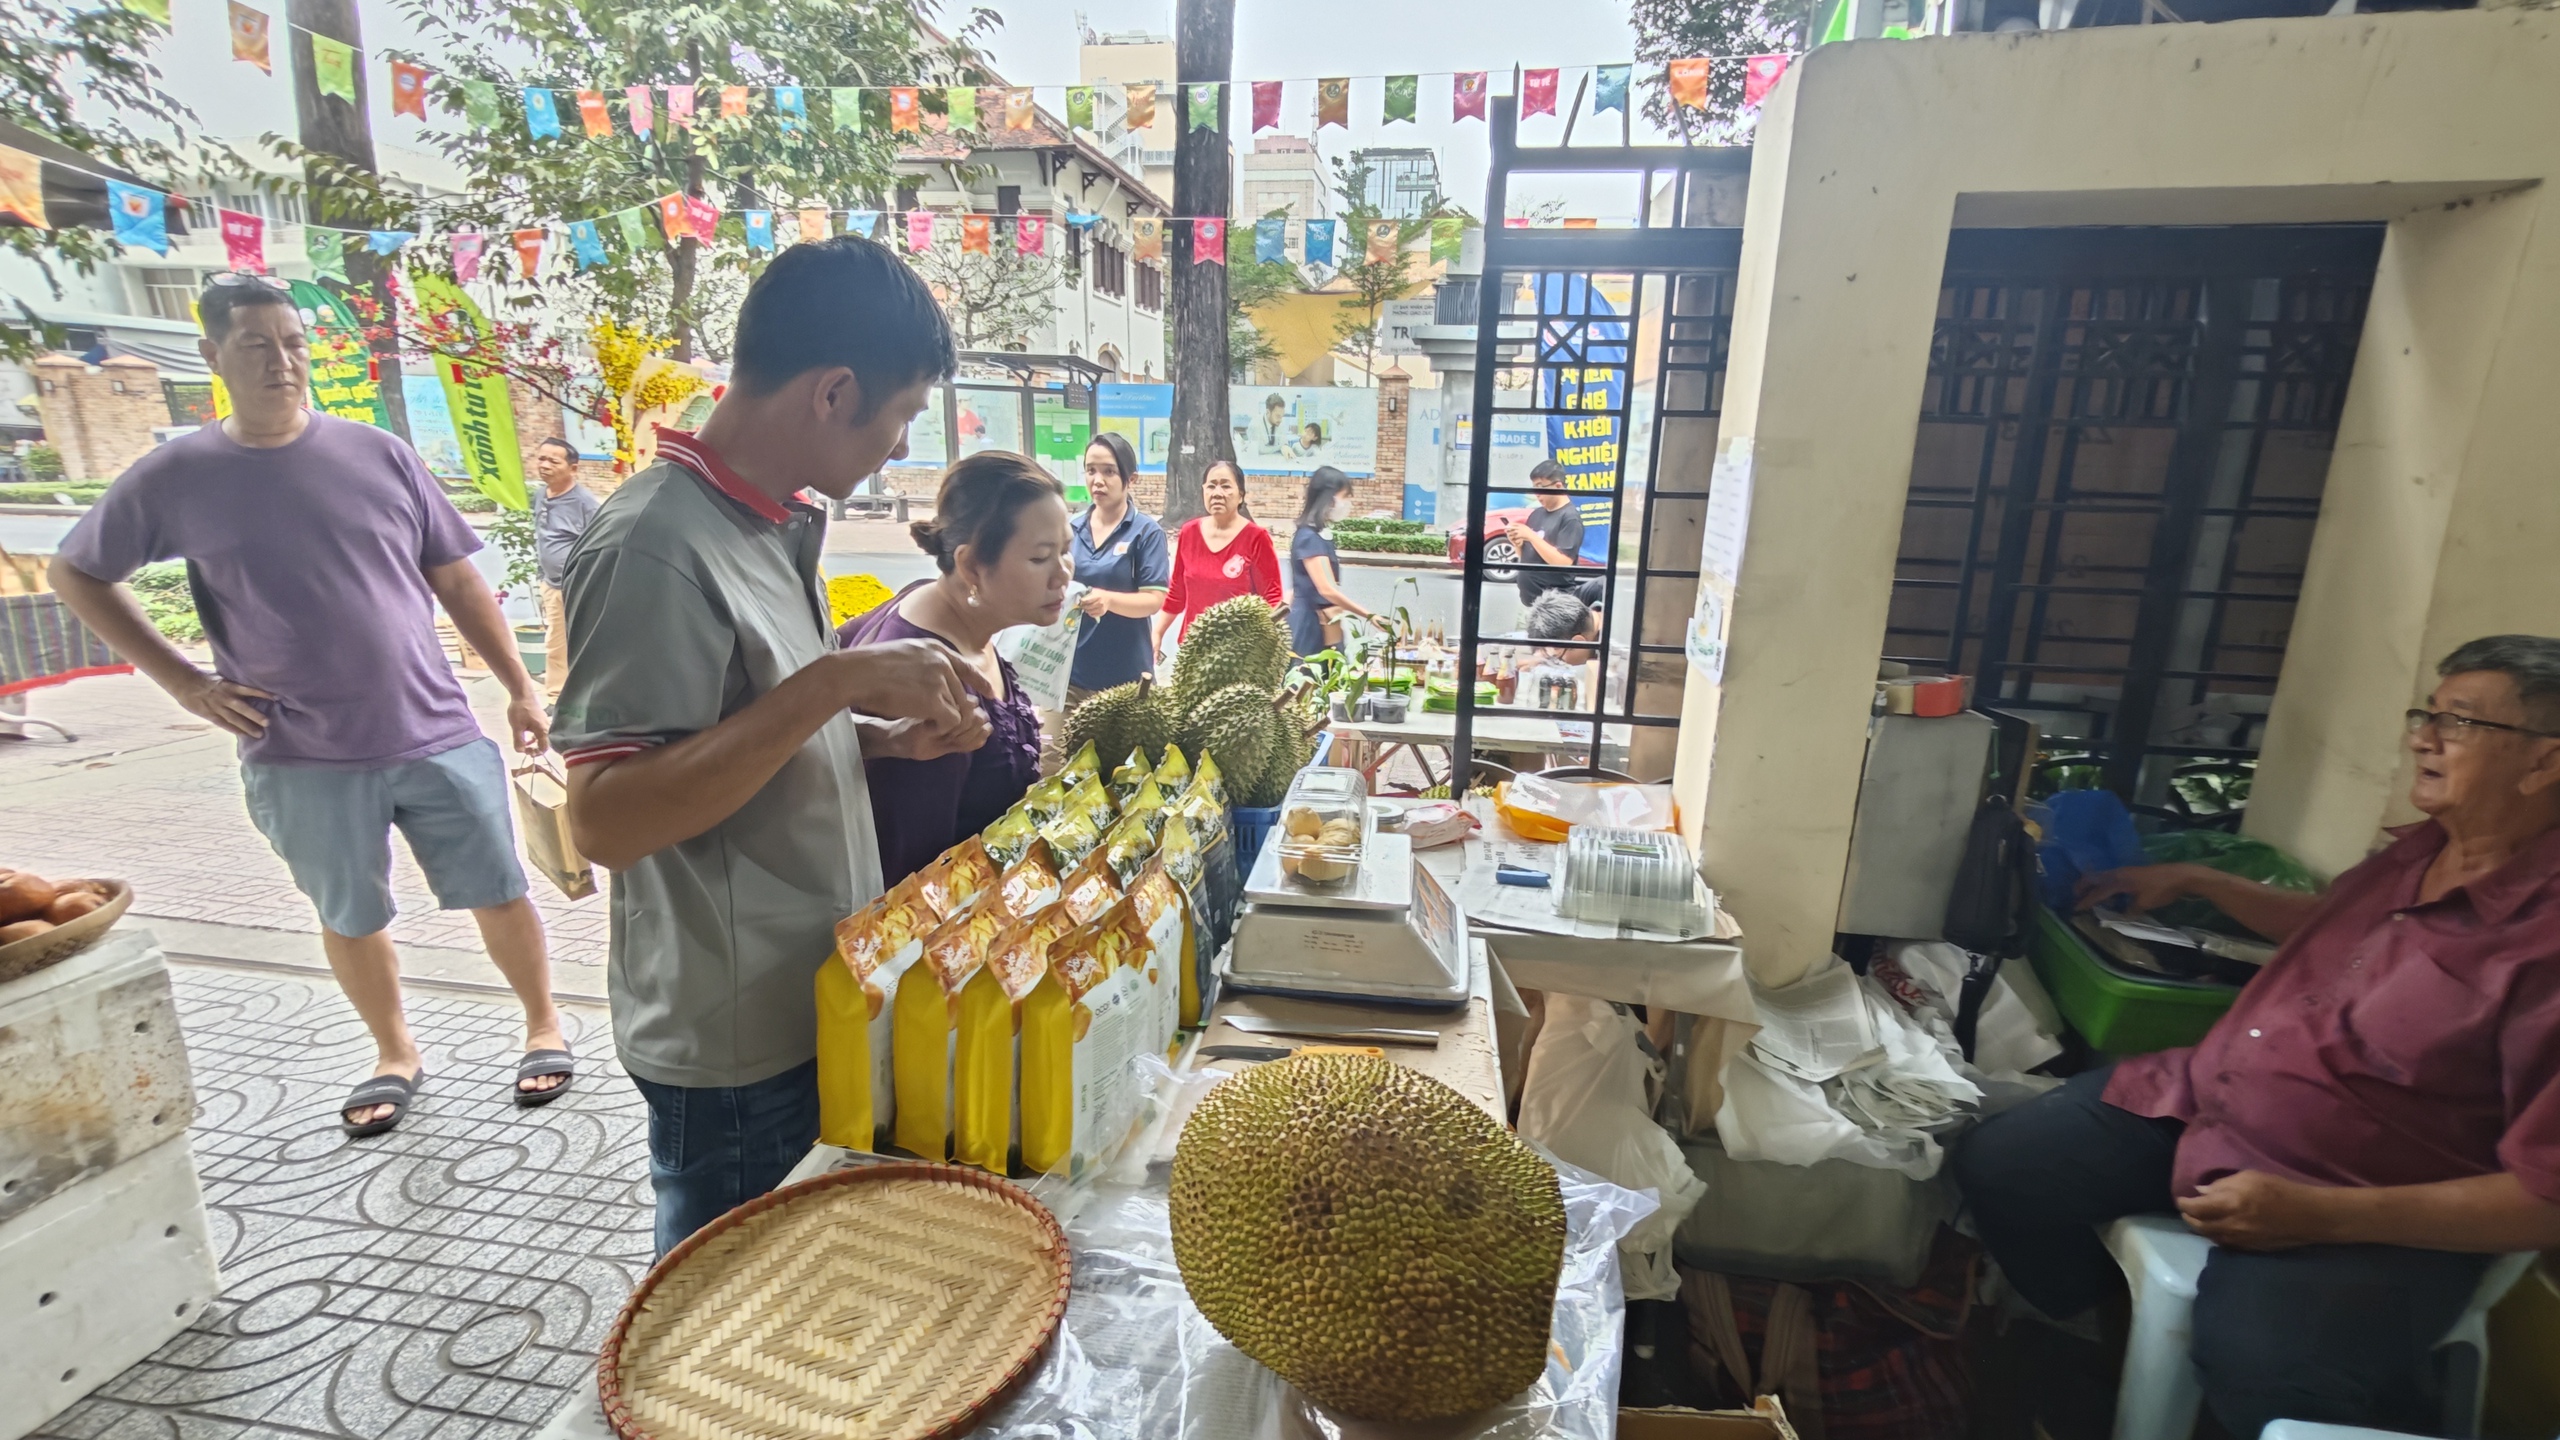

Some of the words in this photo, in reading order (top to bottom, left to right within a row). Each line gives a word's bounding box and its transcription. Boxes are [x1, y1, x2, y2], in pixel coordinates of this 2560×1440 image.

[462, 419, 502, 480] xanh
[1493, 434, 1527, 445] GRADE
[1529, 435, 1536, 445] 5
[1565, 470, 1617, 491] XANH
